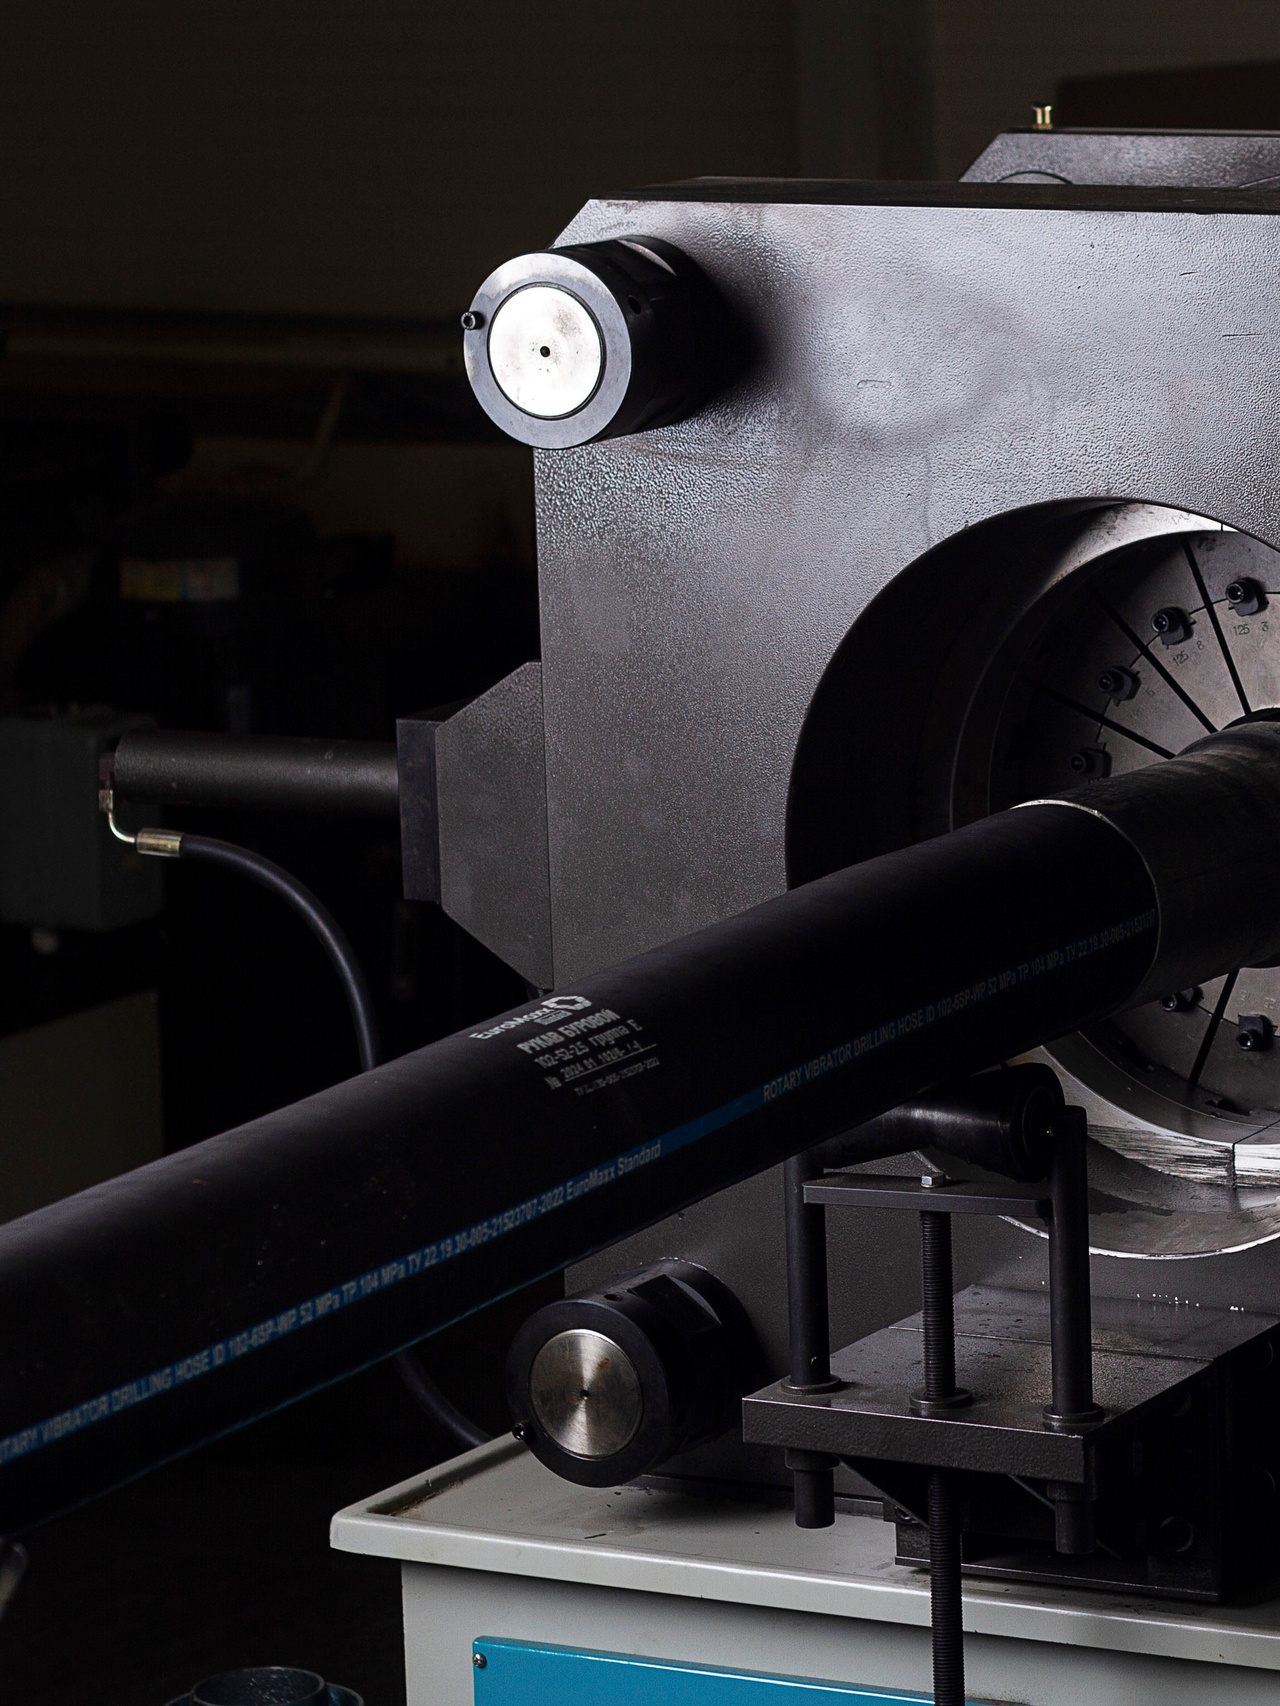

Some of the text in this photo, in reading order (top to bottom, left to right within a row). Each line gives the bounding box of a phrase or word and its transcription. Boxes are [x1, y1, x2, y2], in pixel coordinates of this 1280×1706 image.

[1233, 624, 1250, 636] 125
[1172, 650, 1190, 667] 125
[516, 1031, 566, 1055] РУКАВ
[557, 1008, 621, 1038] БУРОВОЙ
[588, 1025, 631, 1047] группа
[763, 1069, 802, 1103] ROTARY
[803, 1042, 852, 1081] VIBRATOR
[853, 1021, 897, 1057] DRILLING
[897, 1009, 924, 1040] HOSE
[40, 1394, 111, 1444] VIBRATOR
[112, 1371, 174, 1413] DRILLING
[175, 1348, 211, 1385] HOSE
[566, 1164, 616, 1201] EuroMaxx
[617, 1139, 662, 1177] Standard
